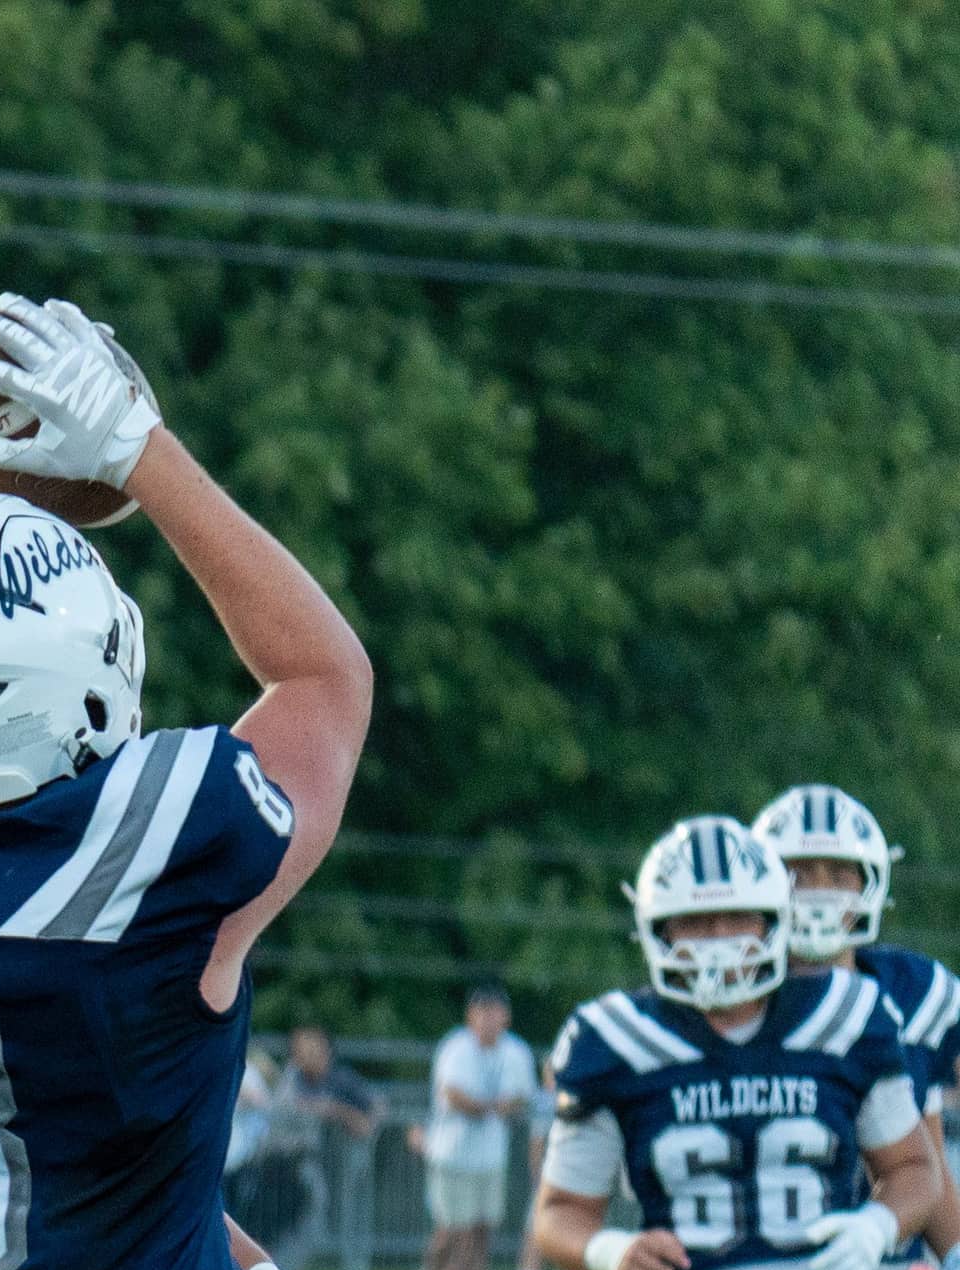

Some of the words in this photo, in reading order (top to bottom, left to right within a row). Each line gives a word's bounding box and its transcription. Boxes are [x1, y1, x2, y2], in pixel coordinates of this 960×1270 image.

[233, 750, 295, 838] 8
[670, 1075, 819, 1123] WILDCATS
[651, 1116, 839, 1250] 66
